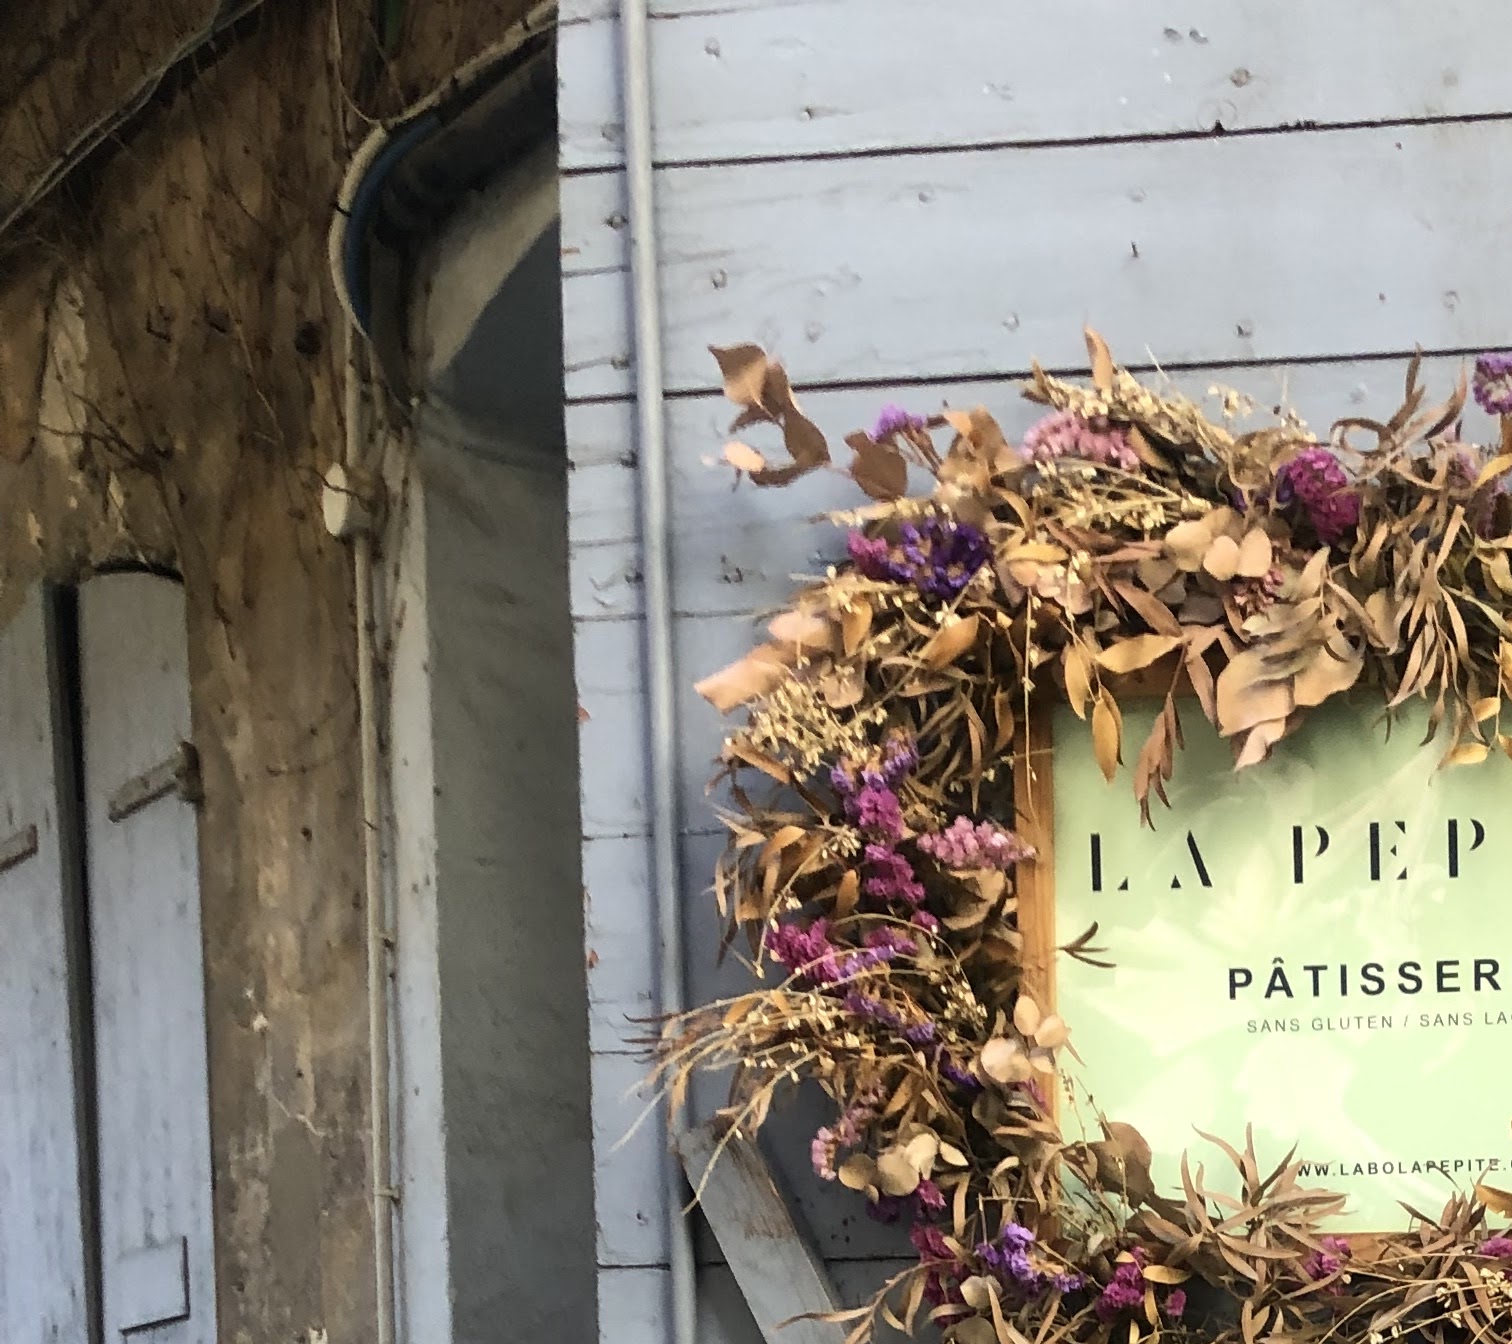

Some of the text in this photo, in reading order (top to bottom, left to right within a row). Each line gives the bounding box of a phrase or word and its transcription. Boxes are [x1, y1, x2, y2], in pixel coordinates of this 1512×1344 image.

[1090, 829, 1213, 892] LA
[1246, 1018, 1301, 1034] SANS
[1311, 1015, 1393, 1032] GLUTEN
[1403, 1014, 1409, 1028] /
[1419, 1012, 1473, 1028] SANS
